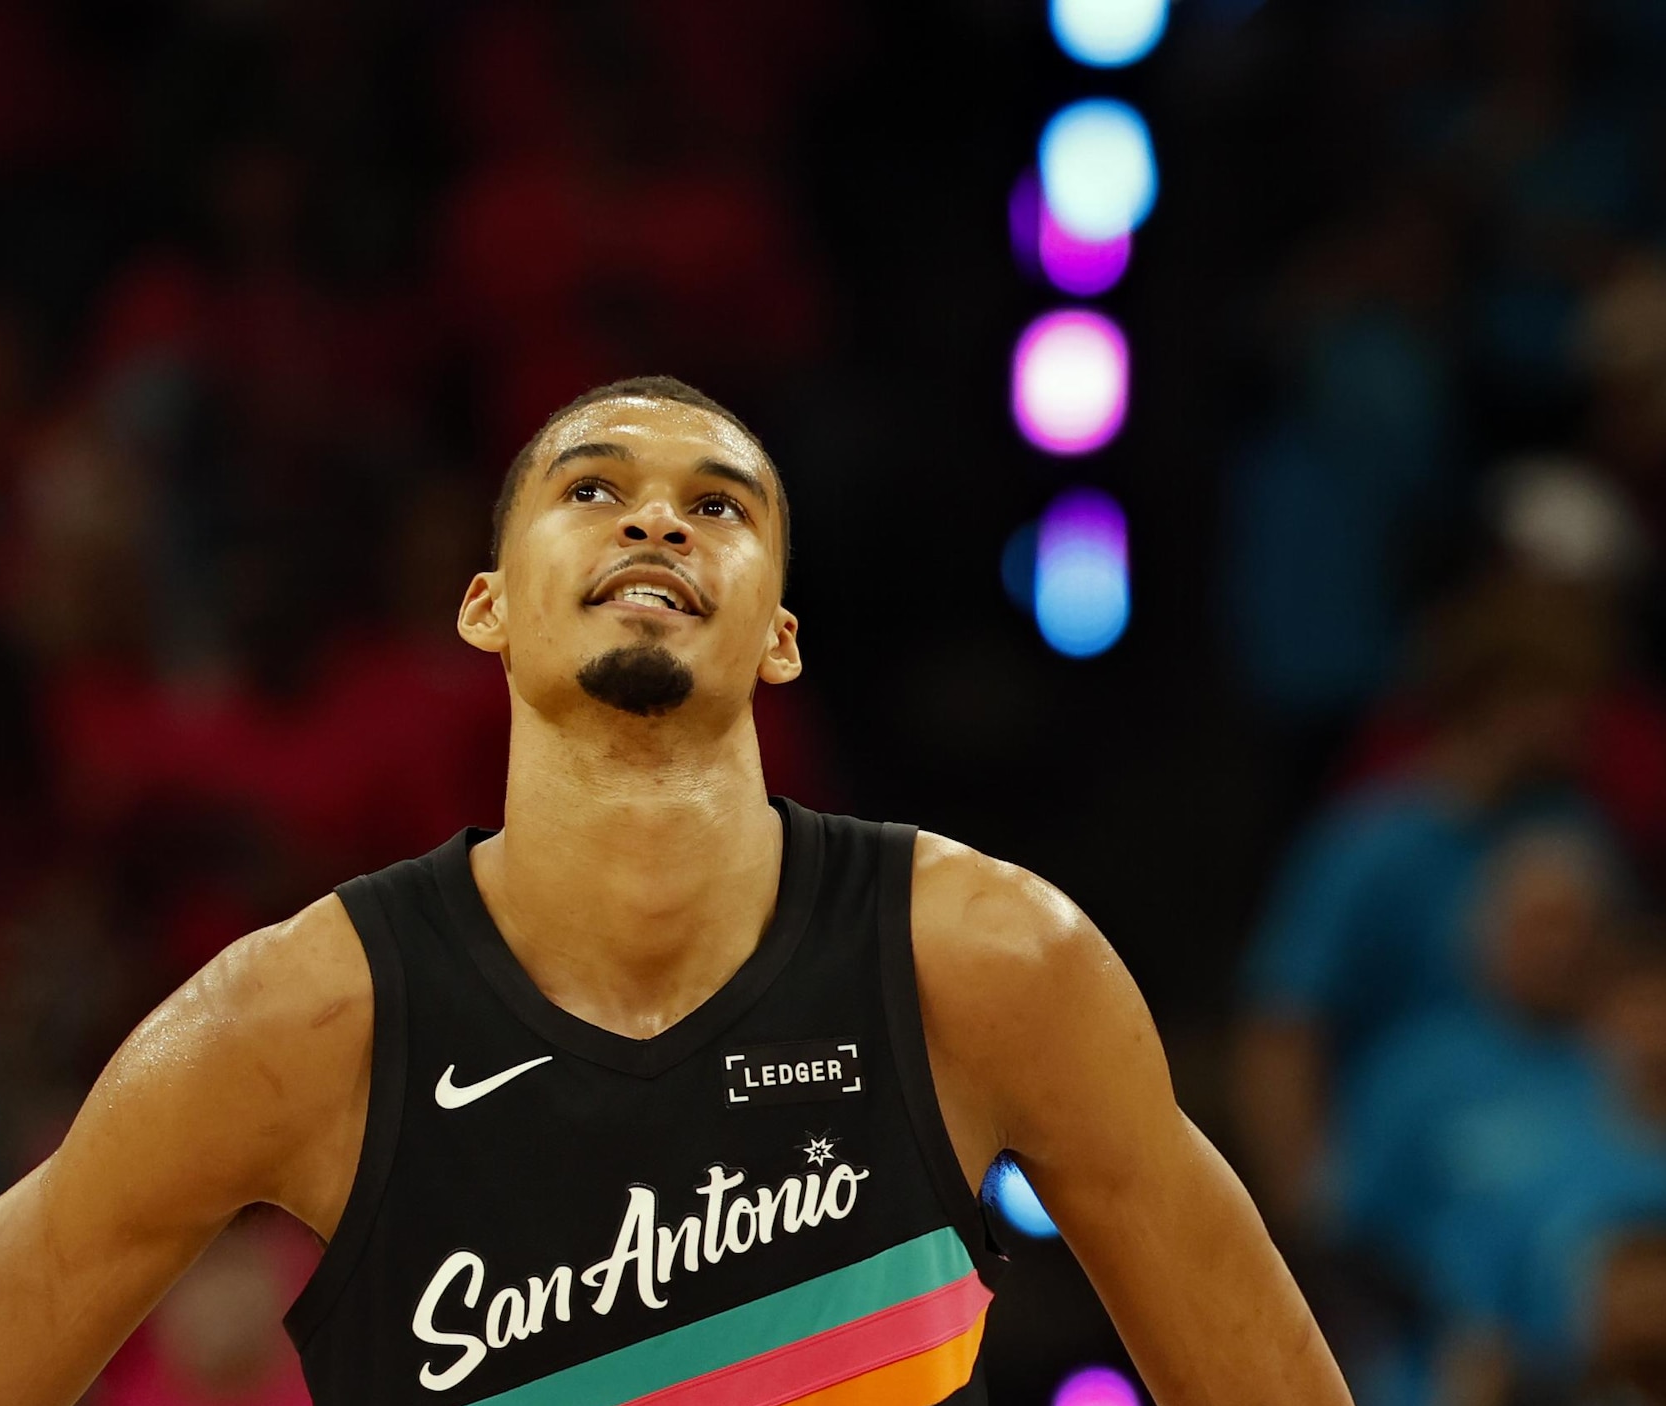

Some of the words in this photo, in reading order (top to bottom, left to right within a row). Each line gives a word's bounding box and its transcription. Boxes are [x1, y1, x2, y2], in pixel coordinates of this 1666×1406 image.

[744, 1060, 842, 1088] LEDGER
[411, 1250, 573, 1391] San
[581, 1137, 870, 1315] Antonio
